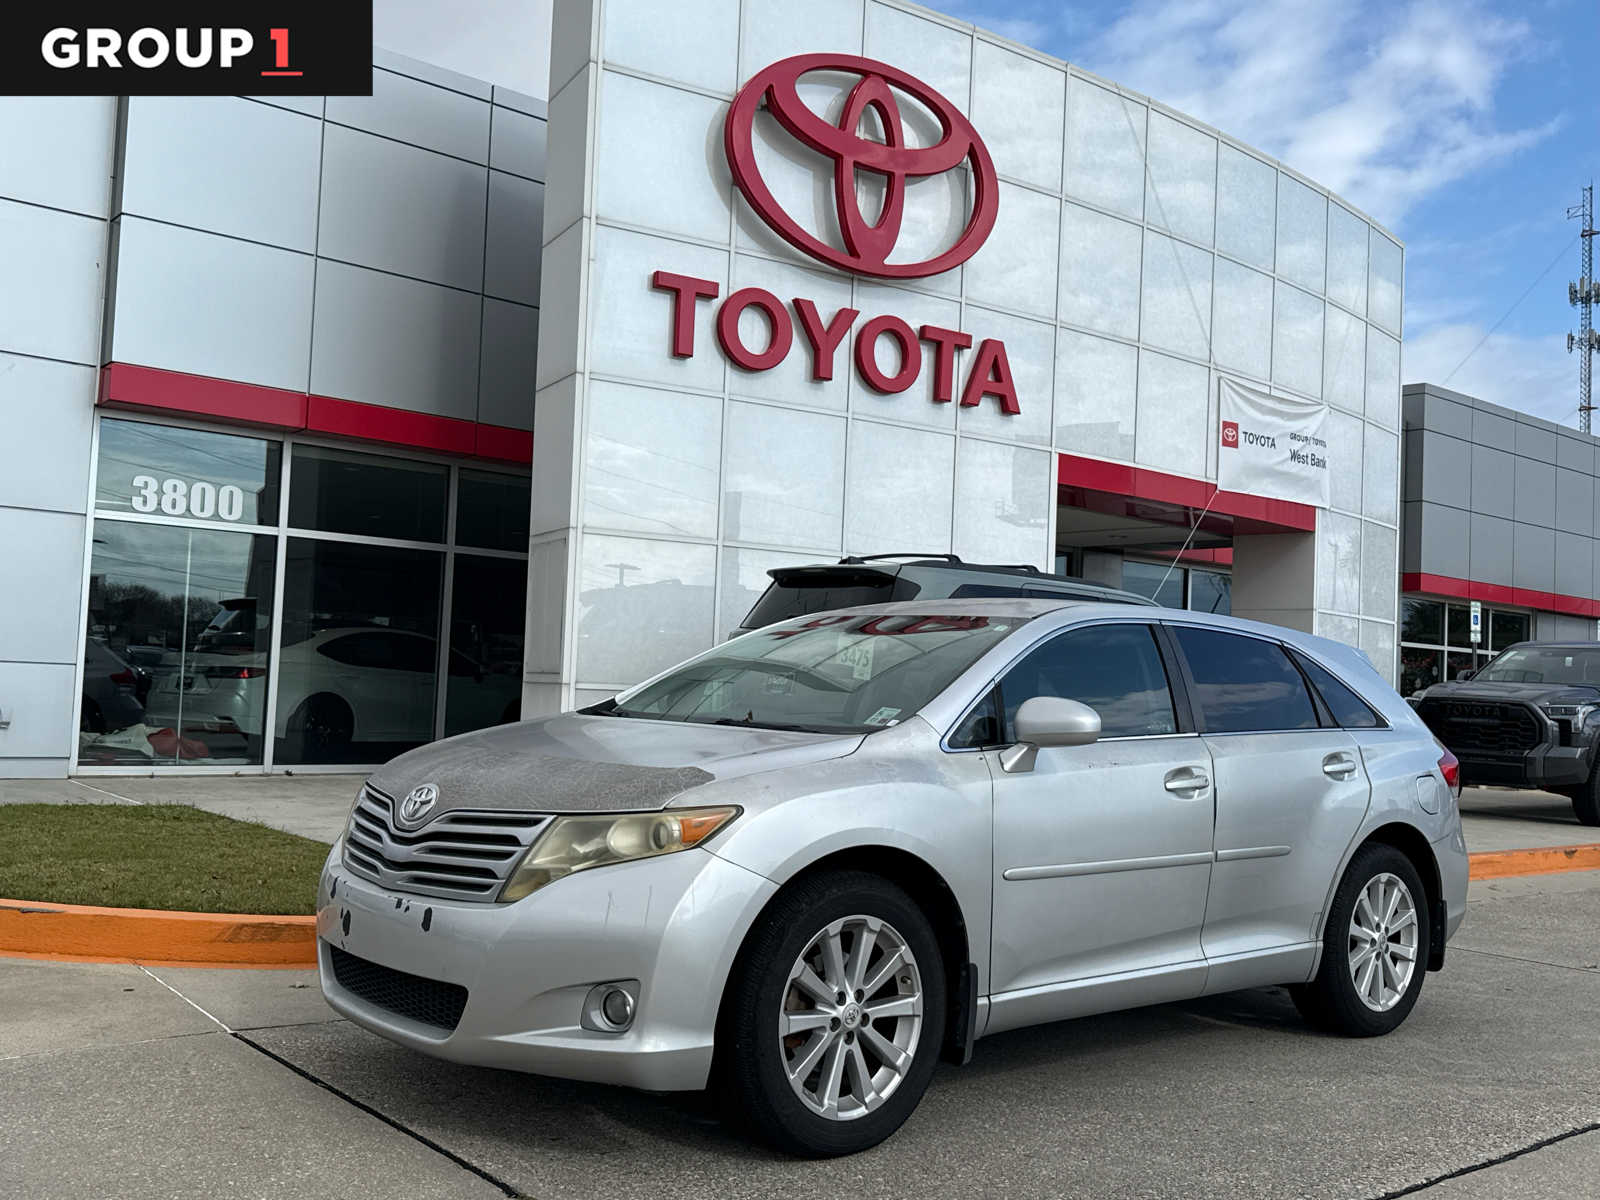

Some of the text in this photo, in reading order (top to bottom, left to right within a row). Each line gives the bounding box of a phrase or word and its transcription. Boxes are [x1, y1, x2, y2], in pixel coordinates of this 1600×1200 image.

[653, 270, 1021, 415] TOYOTA
[1242, 431, 1276, 449] TOYOTA
[1289, 448, 1327, 469] West Bank
[131, 476, 243, 521] 3800
